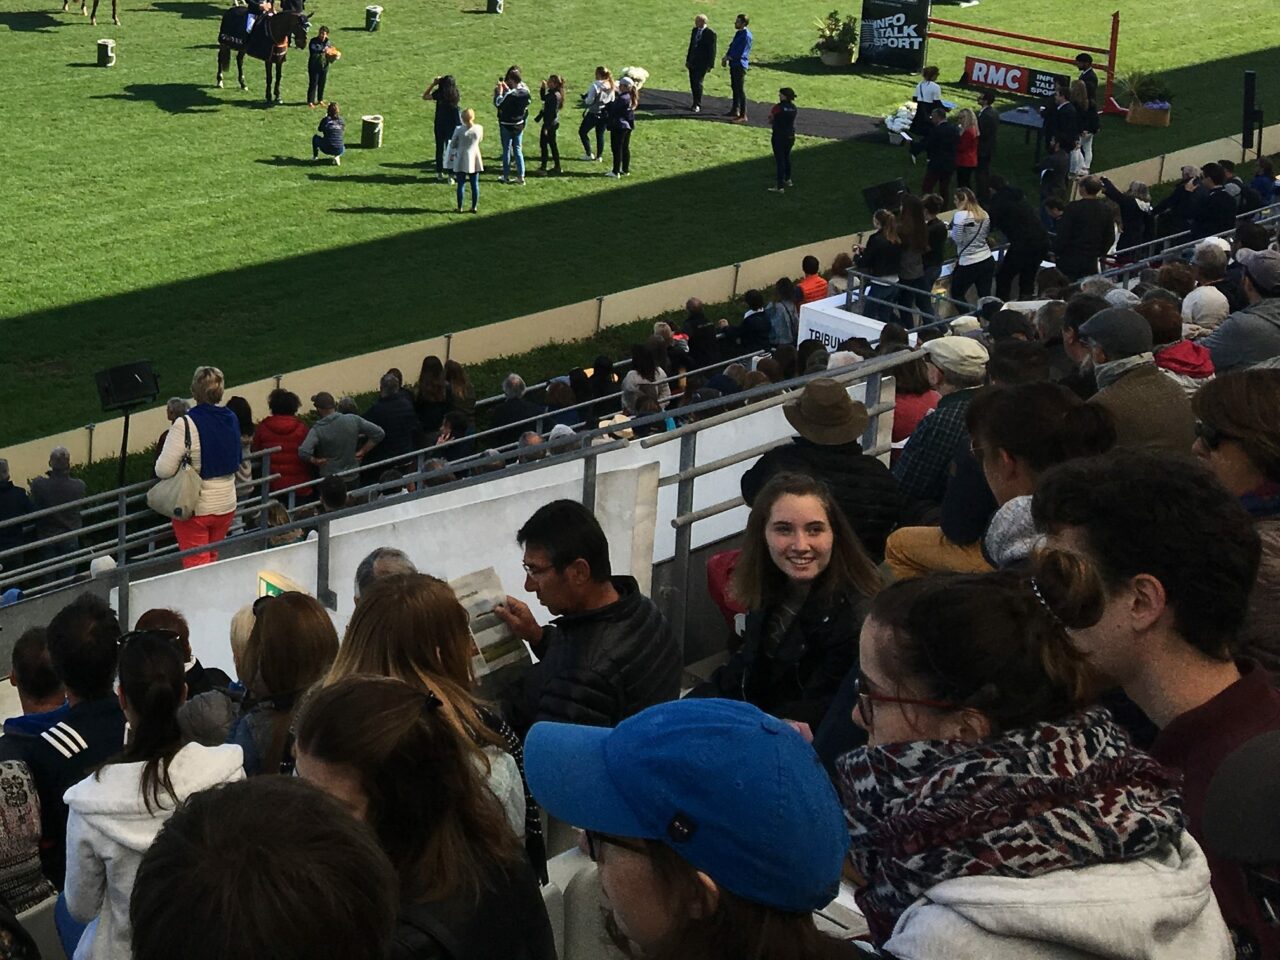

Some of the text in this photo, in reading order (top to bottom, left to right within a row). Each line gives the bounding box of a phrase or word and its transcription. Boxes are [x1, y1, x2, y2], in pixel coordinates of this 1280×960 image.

[873, 13, 906, 29] INFO
[878, 24, 918, 38] TALK
[873, 37, 923, 50] SPORT
[972, 62, 1022, 89] RMC
